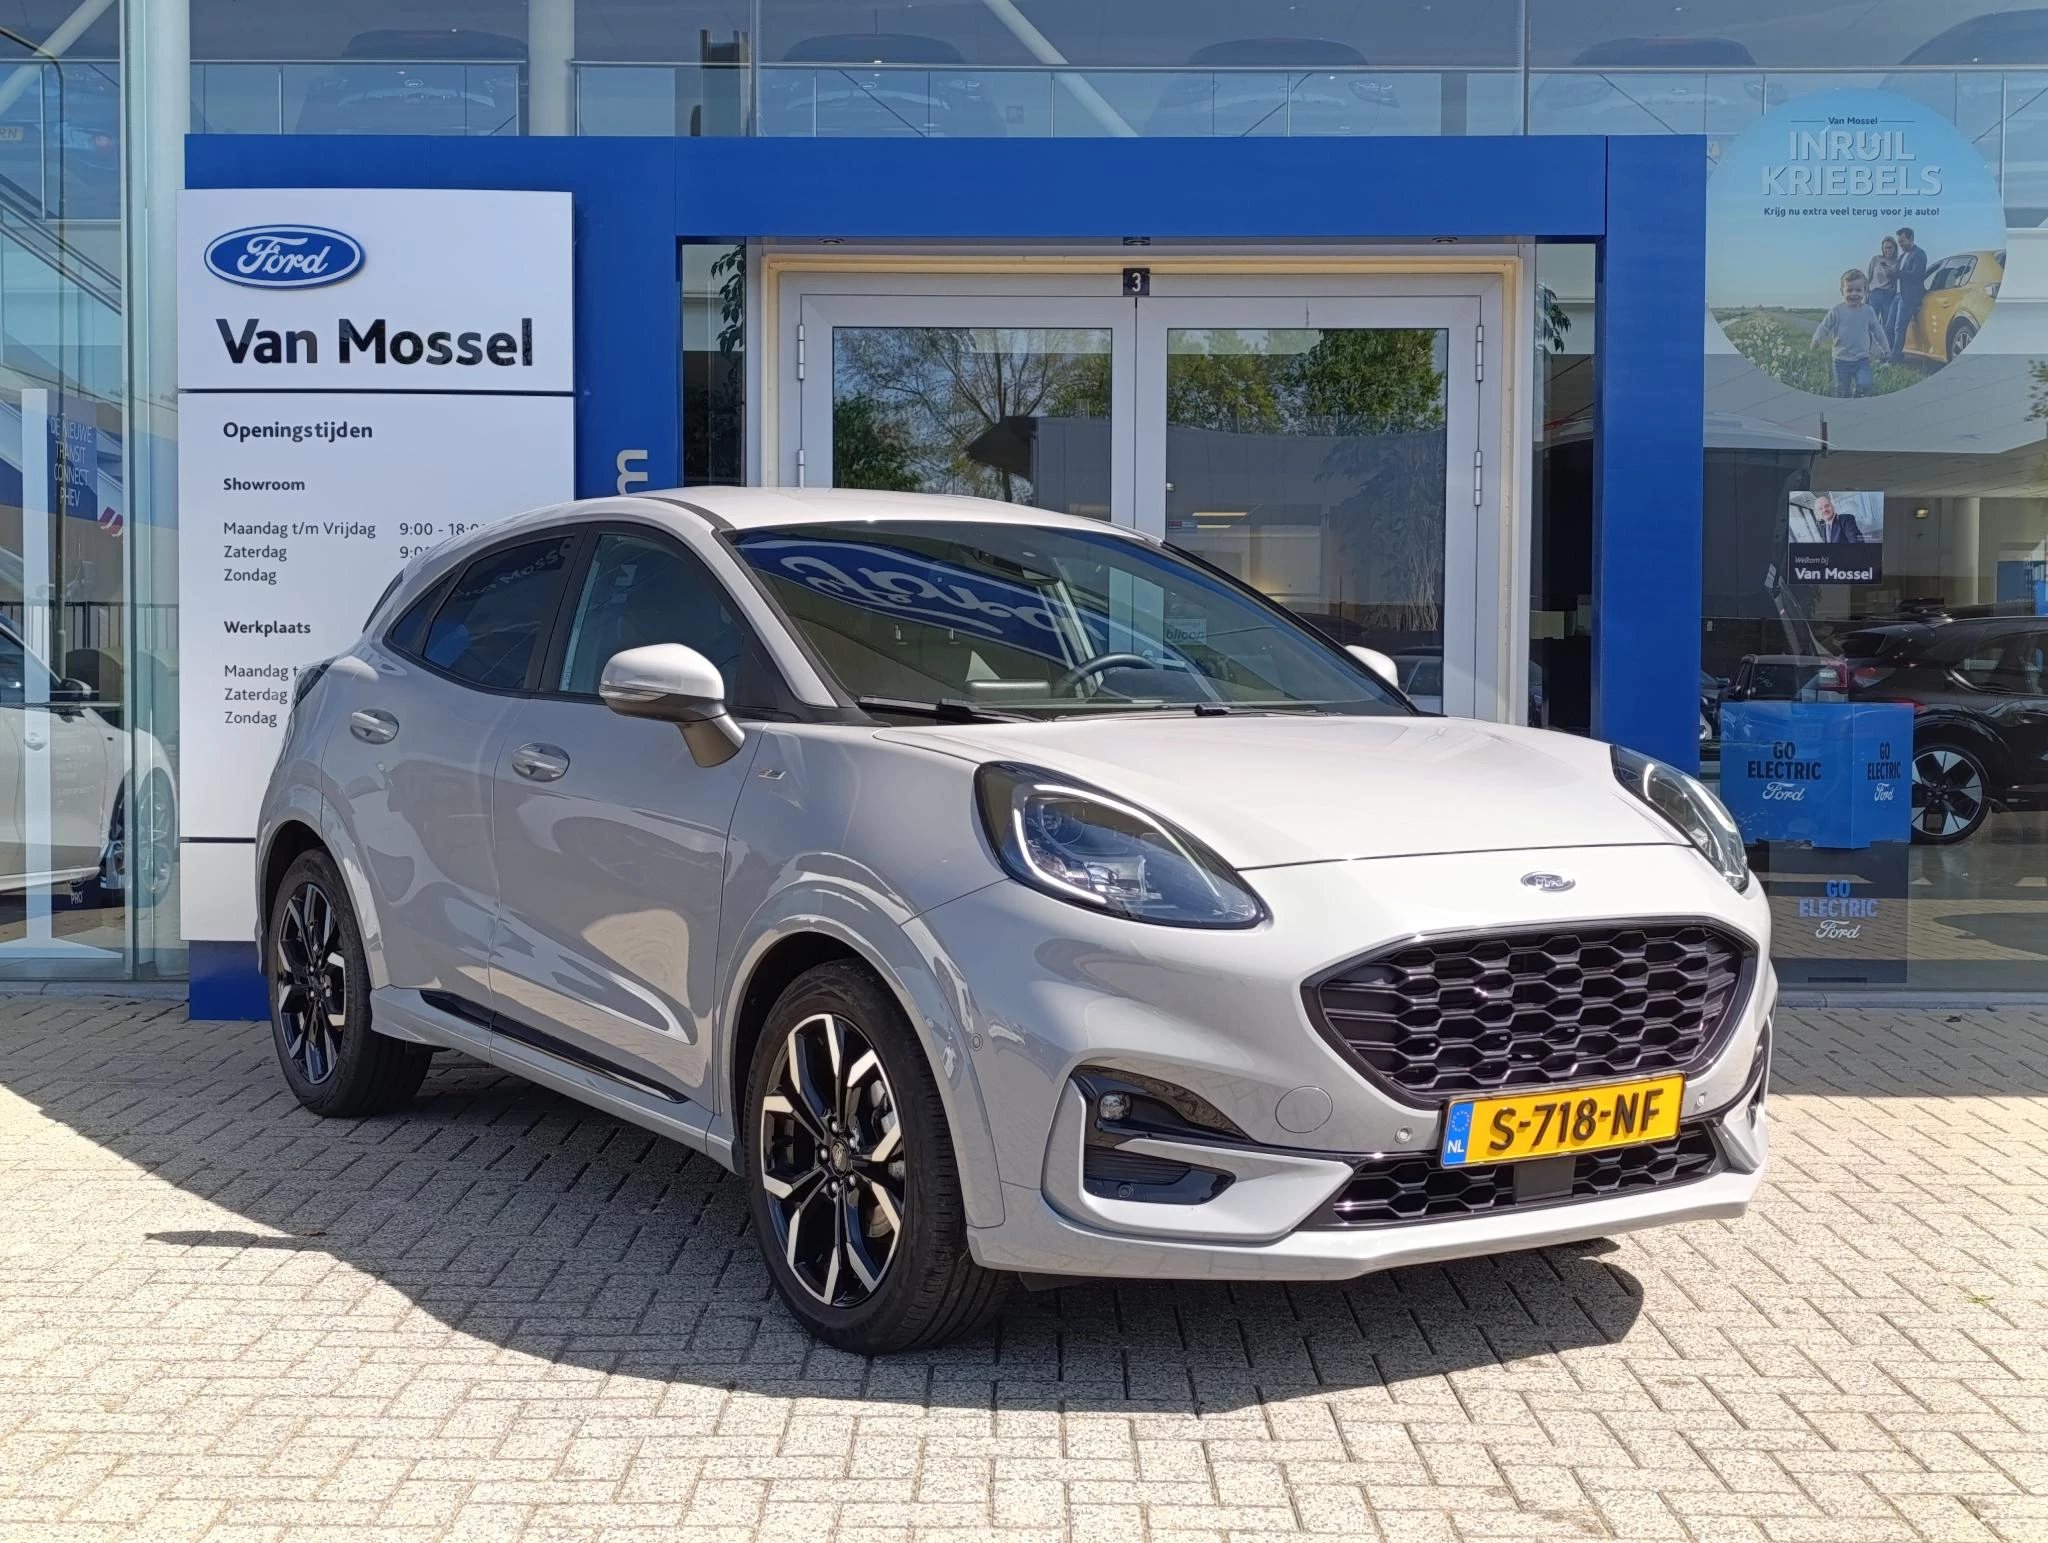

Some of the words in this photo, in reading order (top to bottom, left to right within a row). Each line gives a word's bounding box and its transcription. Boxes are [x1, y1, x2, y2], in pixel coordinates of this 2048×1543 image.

[1828, 117, 1844, 125] Van
[1848, 116, 1878, 125] Mossel
[1790, 131, 1916, 161] INRUIL
[1761, 166, 1943, 196] KRIEBELS
[1764, 207, 1786, 217] Krijg
[1803, 208, 1828, 216] extra
[1830, 207, 1850, 216] veel
[1852, 208, 1878, 217] terug
[1904, 207, 1913, 217] je
[1915, 207, 1940, 216] auto!
[237, 235, 331, 274] Ford
[1132, 272, 1141, 292] 3
[216, 318, 318, 364] Van
[338, 317, 533, 366] Mossel
[223, 421, 373, 443] Openingstijden
[223, 477, 305, 491] Showroom
[223, 521, 288, 538] Maandag
[292, 521, 319, 535] t/m
[323, 521, 376, 539] Vrijdag
[399, 522, 433, 535] 9:00
[223, 544, 287, 562] Zaterdag
[1795, 556, 1819, 564] Welkom
[1821, 556, 1829, 566] bij
[224, 568, 277, 585] Zondag
[1794, 567, 1821, 580] Van
[1825, 567, 1873, 580] Mossel
[223, 620, 311, 638] Werkplaats
[224, 664, 289, 682] Maandag
[224, 687, 288, 704] Zaterdag
[224, 711, 277, 727] Zondag
[1773, 742, 1796, 760] GO
[1880, 742, 1891, 760] GO
[1747, 760, 1822, 780] ELECTRIC
[1867, 762, 1901, 780] ELECTRIC
[1762, 781, 1805, 801] Ford
[1874, 782, 1894, 801] Ford
[1826, 879, 1851, 898] GO
[1799, 898, 1878, 917] ELECTRIC
[1815, 920, 1861, 939] Ford
[1489, 1088, 1664, 1151] S-718-NF
[1447, 1139, 1465, 1153] NL
